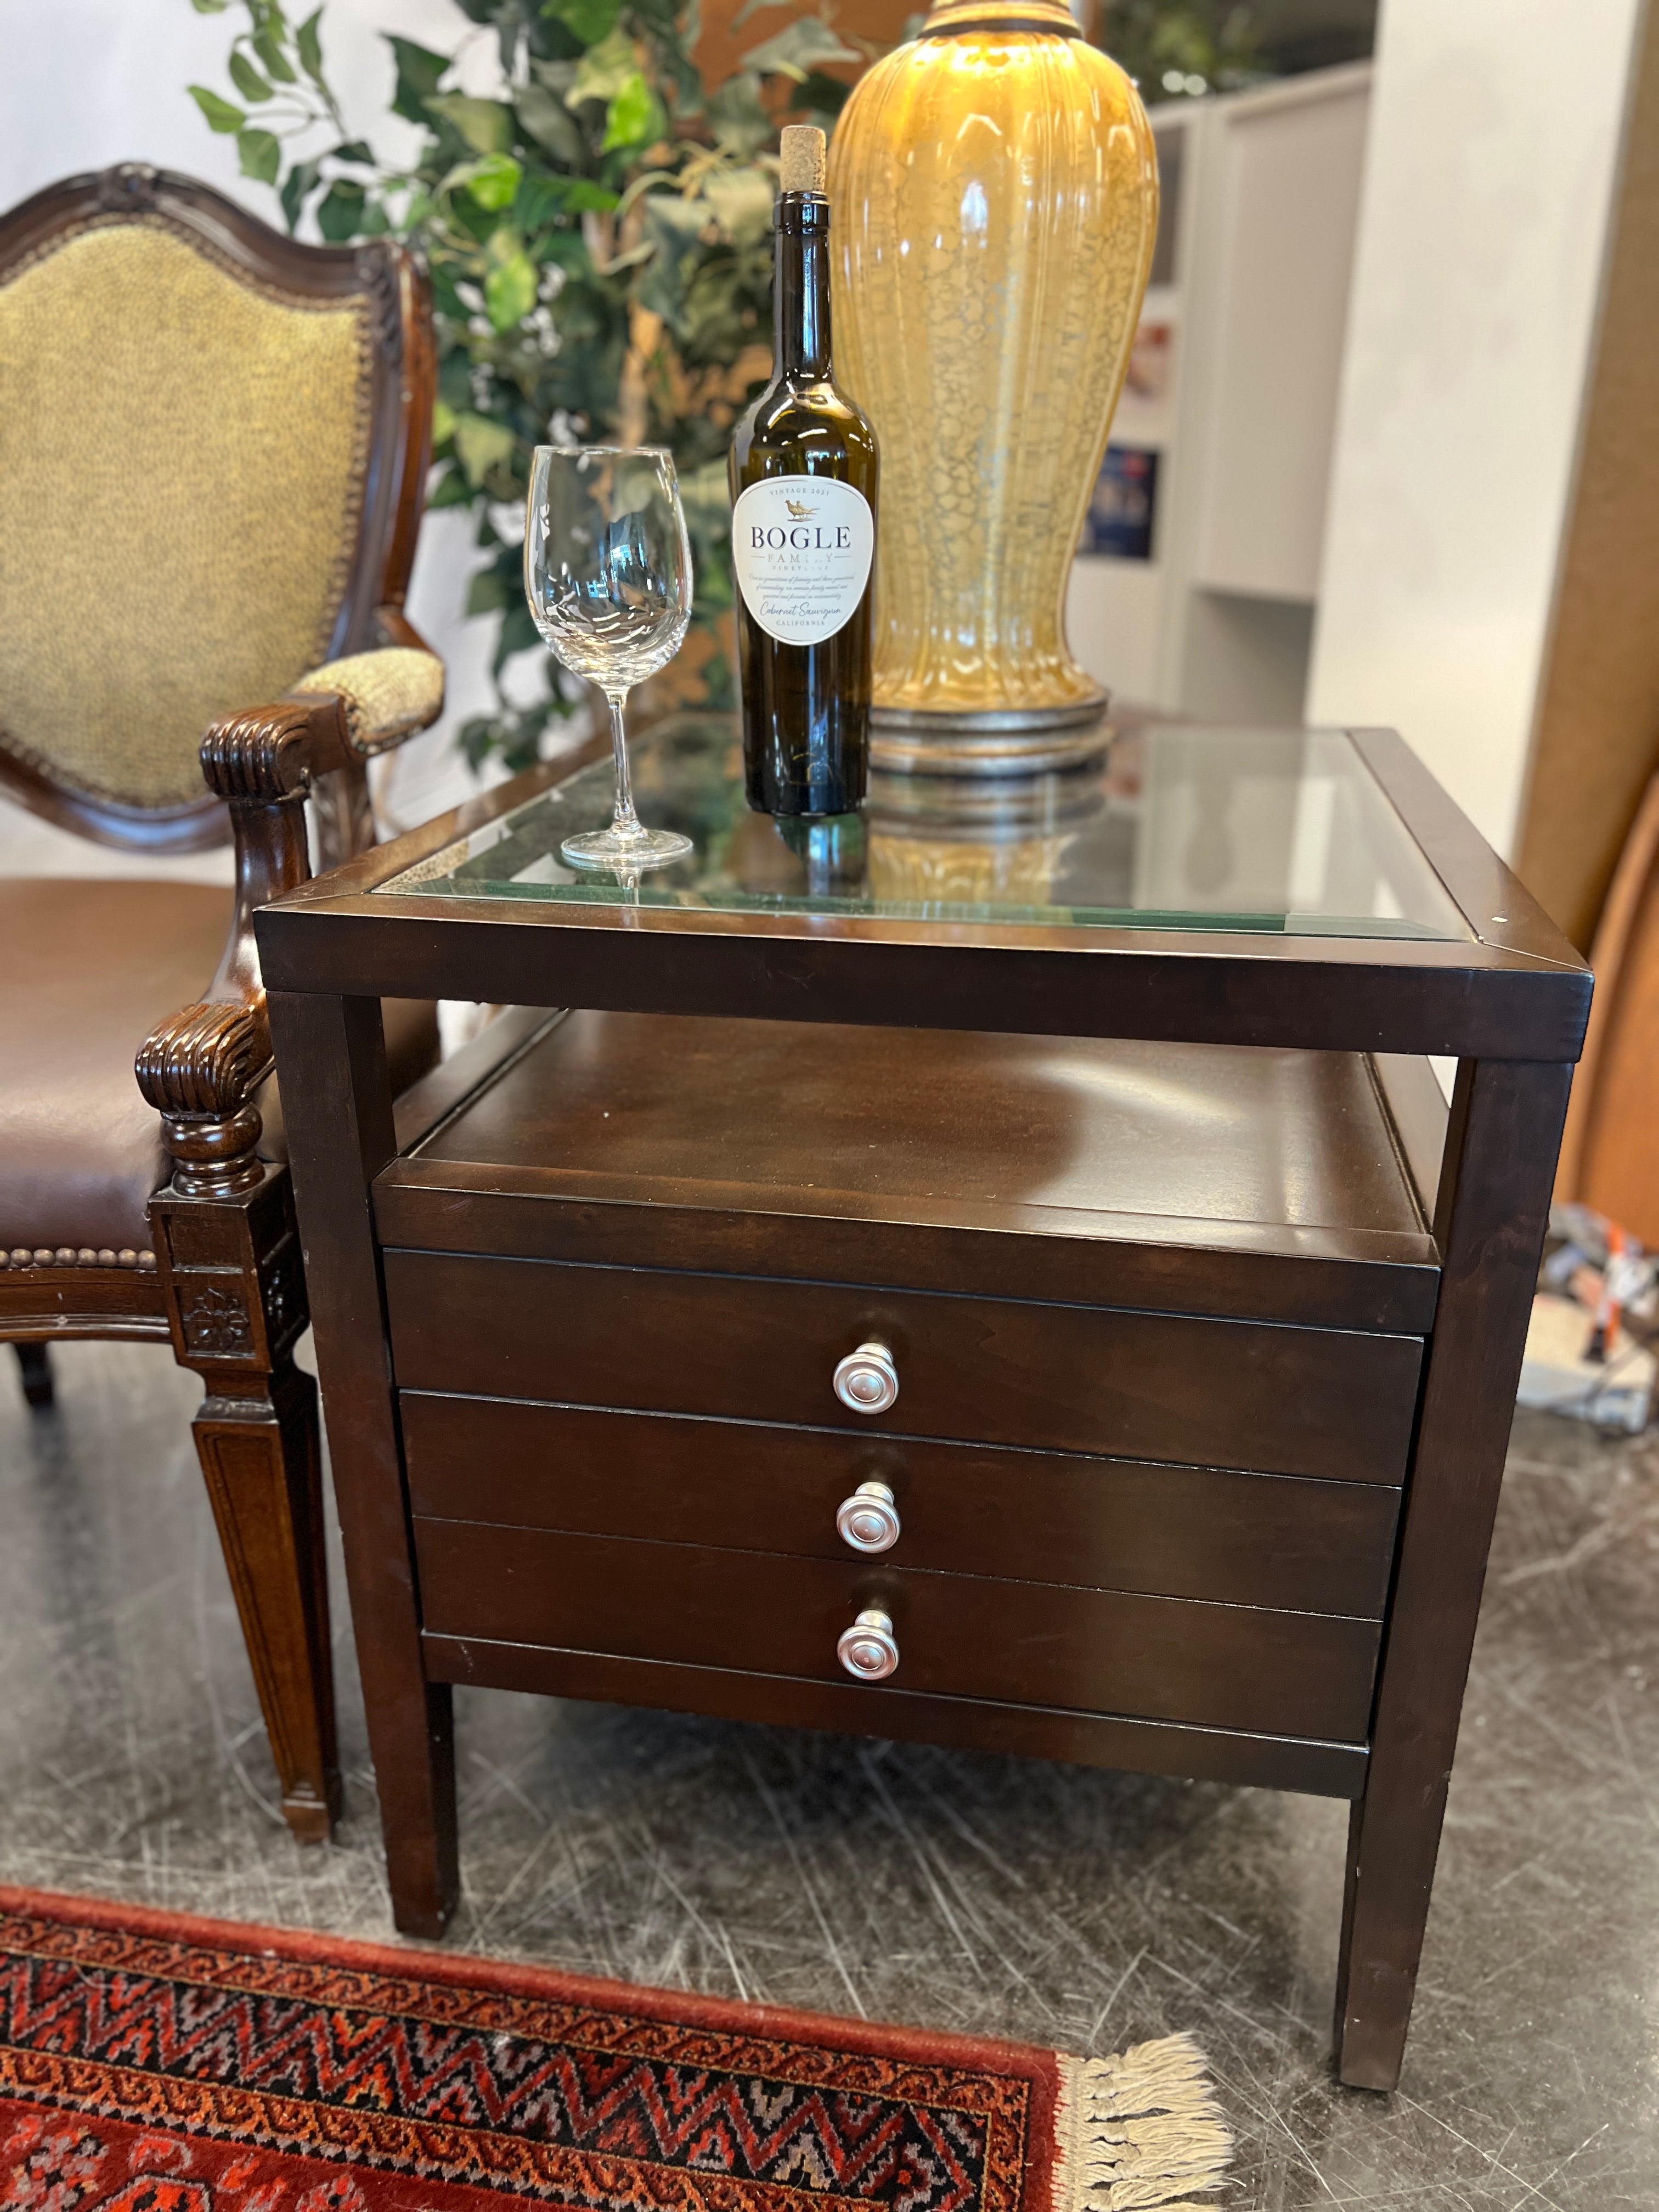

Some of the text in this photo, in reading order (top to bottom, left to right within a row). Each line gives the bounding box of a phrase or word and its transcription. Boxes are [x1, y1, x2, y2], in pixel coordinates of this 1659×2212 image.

[751, 526, 851, 550] BOGLE
[768, 553, 833, 562] FAMIY
[760, 601, 841, 619] Cabernet Sauvignon
